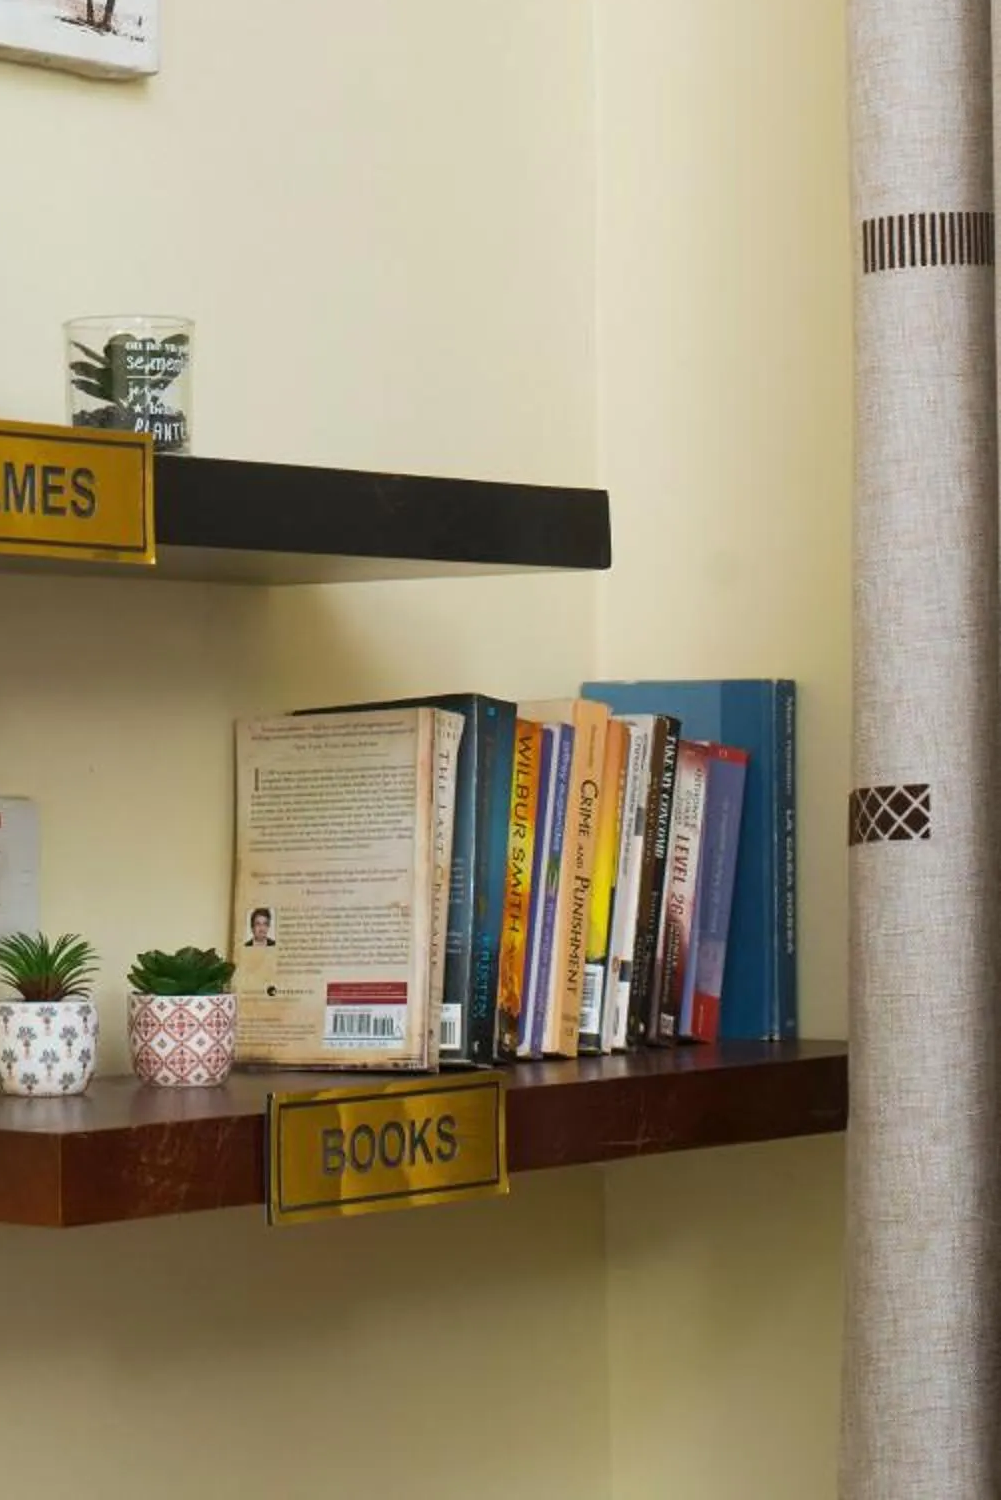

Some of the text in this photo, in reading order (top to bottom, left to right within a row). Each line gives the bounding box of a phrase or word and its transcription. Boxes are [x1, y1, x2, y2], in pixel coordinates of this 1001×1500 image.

[437, 750, 449, 791] THE
[435, 803, 448, 855] LAST
[508, 736, 533, 934] WILBUR SMITH
[577, 779, 599, 838] CRIME
[575, 842, 585, 870] AND
[672, 834, 691, 885] LEVEL
[566, 875, 590, 994] PUNISHMENT
[320, 1113, 459, 1178] BOOKS
